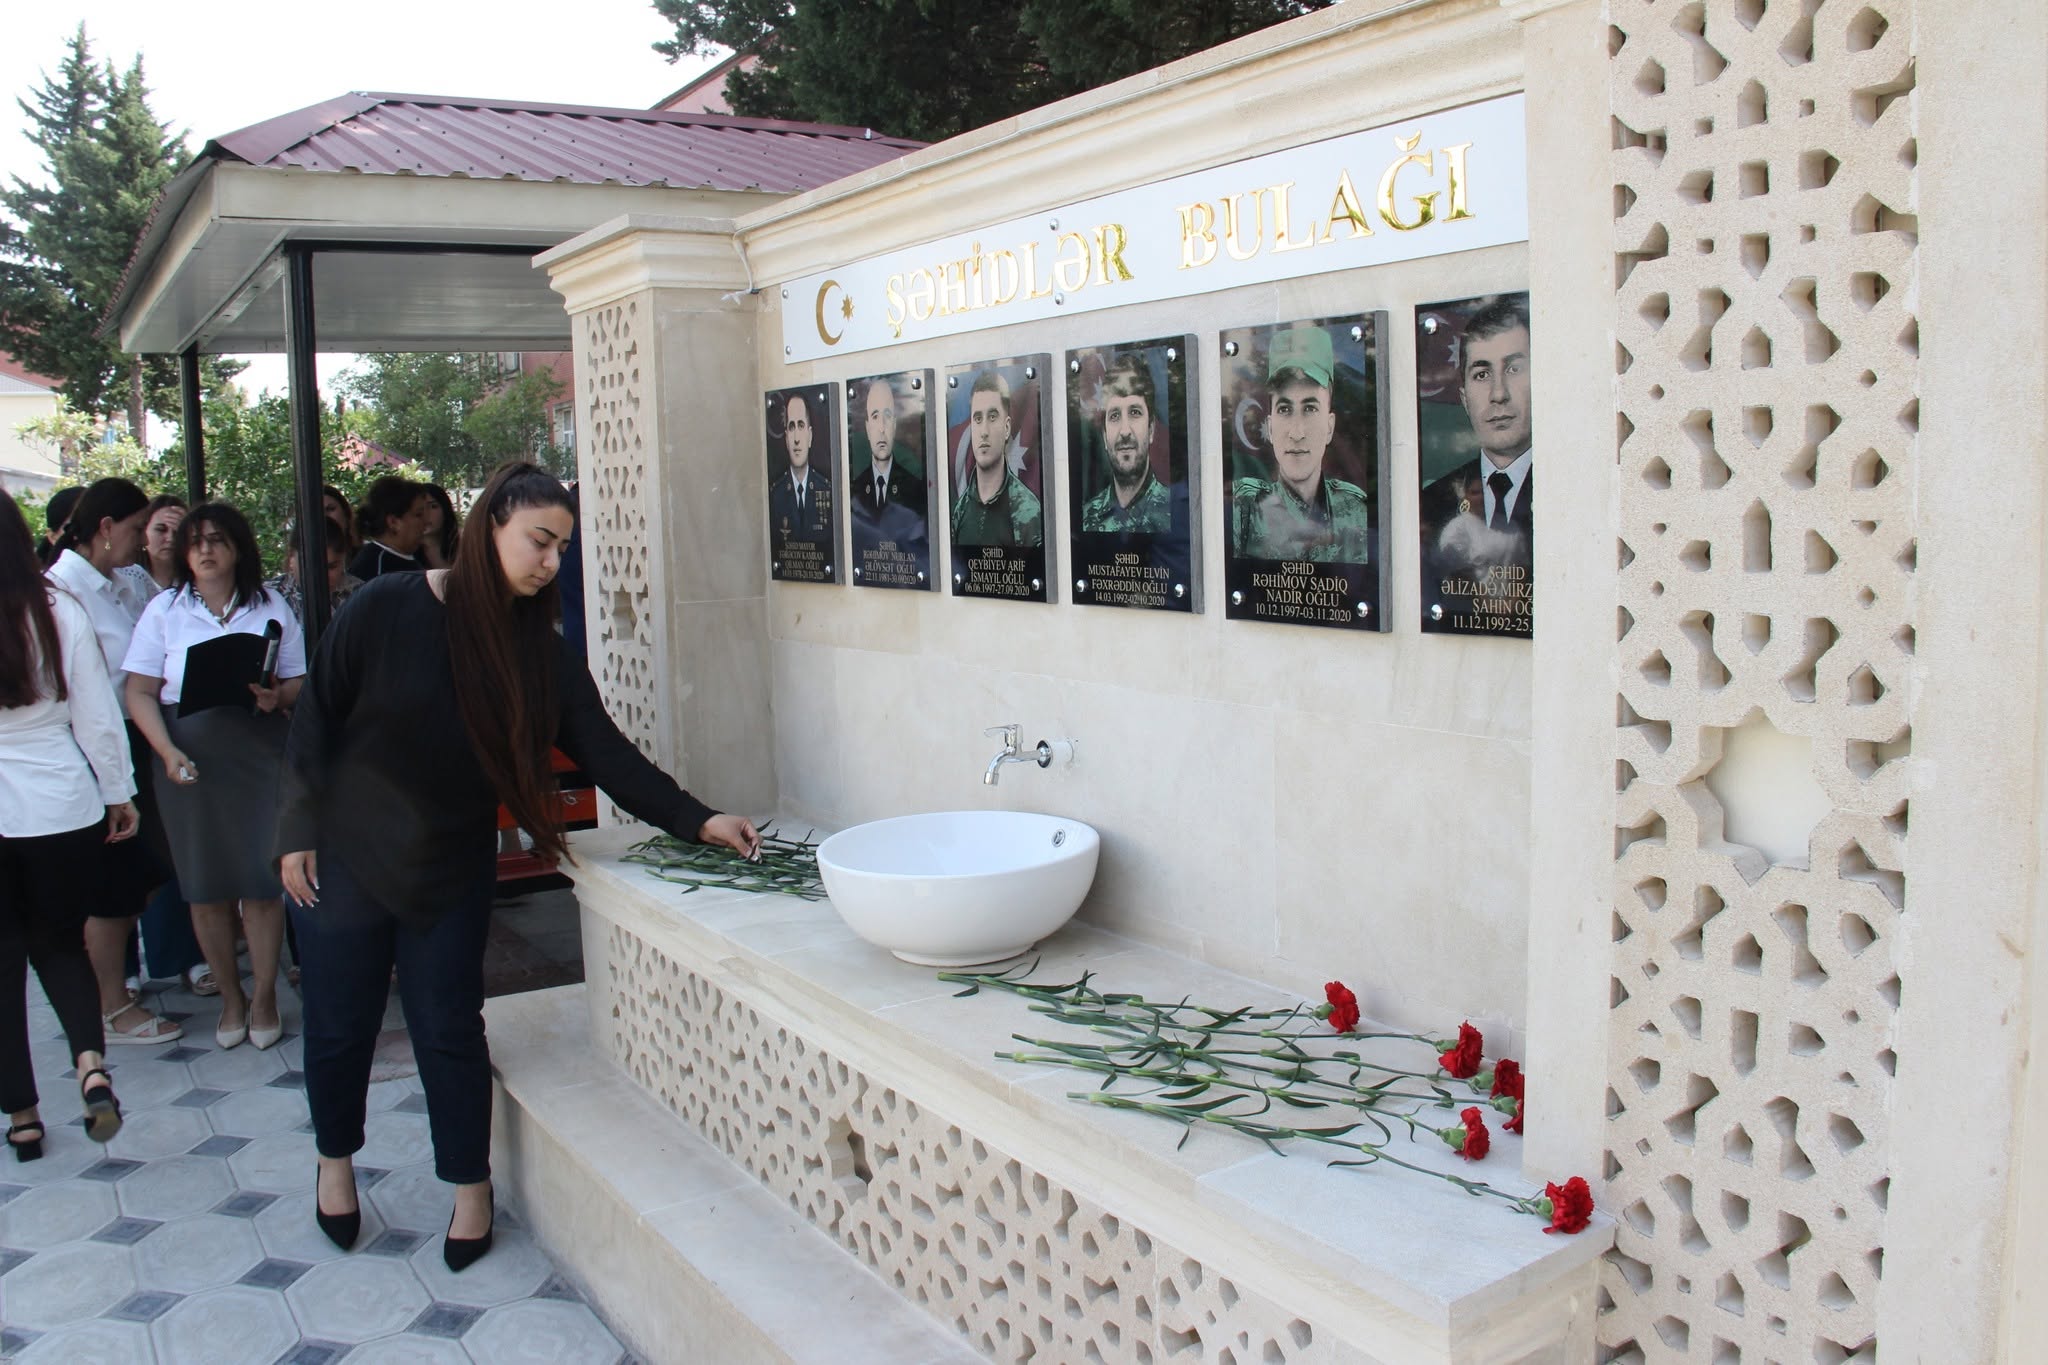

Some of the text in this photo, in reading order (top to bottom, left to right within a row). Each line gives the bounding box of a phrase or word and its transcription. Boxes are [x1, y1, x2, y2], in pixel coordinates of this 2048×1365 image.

[886, 129, 1475, 338] ŞƏHİDLƏR BULAĞI
[891, 551, 916, 562] NURLAN
[982, 546, 1004, 559] ŞƏHİD
[1114, 552, 1140, 566] ŞƏHİD
[865, 560, 916, 575] ƏLÖVSƏT OĞLU
[1007, 558, 1026, 572] ARİF
[1088, 564, 1170, 579] MUSTAFAYEV ELVİN
[1281, 560, 1315, 576] ŞƏHİD
[1488, 563, 1525, 583] ŞƏHİD
[971, 569, 1025, 585] İSMAYIL OĞLU
[1253, 572, 1348, 595] RƏHİMOV SADİQ
[964, 582, 1030, 596] 06.06.1997-27.09.2020
[1091, 578, 1168, 594] FƏXRƏDDİN OĞLU
[1441, 578, 1497, 597] ƏLİZADƏ
[1266, 588, 1340, 607] NADİR OĞLU
[1256, 602, 1352, 622] 10.12.1997-03.11.2020
[1472, 596, 1512, 616] ŞAHİN
